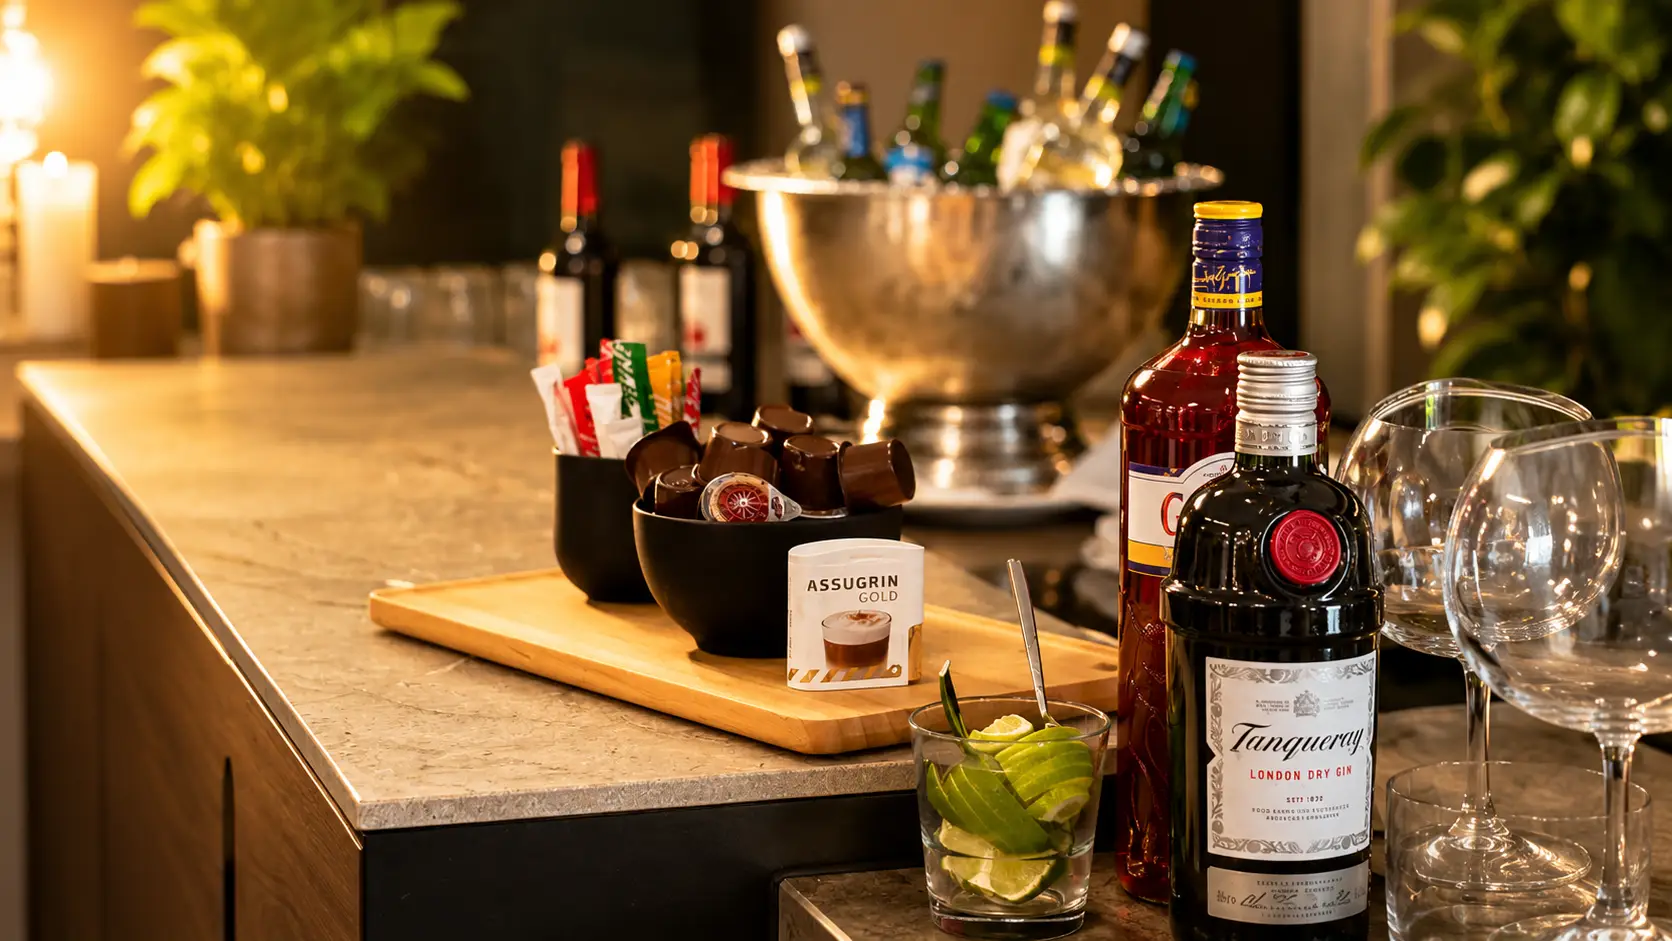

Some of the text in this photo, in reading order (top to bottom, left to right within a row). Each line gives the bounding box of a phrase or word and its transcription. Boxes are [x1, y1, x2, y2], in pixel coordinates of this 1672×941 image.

[807, 575, 898, 592] ASSUGRIN
[858, 590, 898, 603] GOLD
[1229, 722, 1364, 762] Tanqueray
[1250, 765, 1352, 781] LONDON DRY GIN
